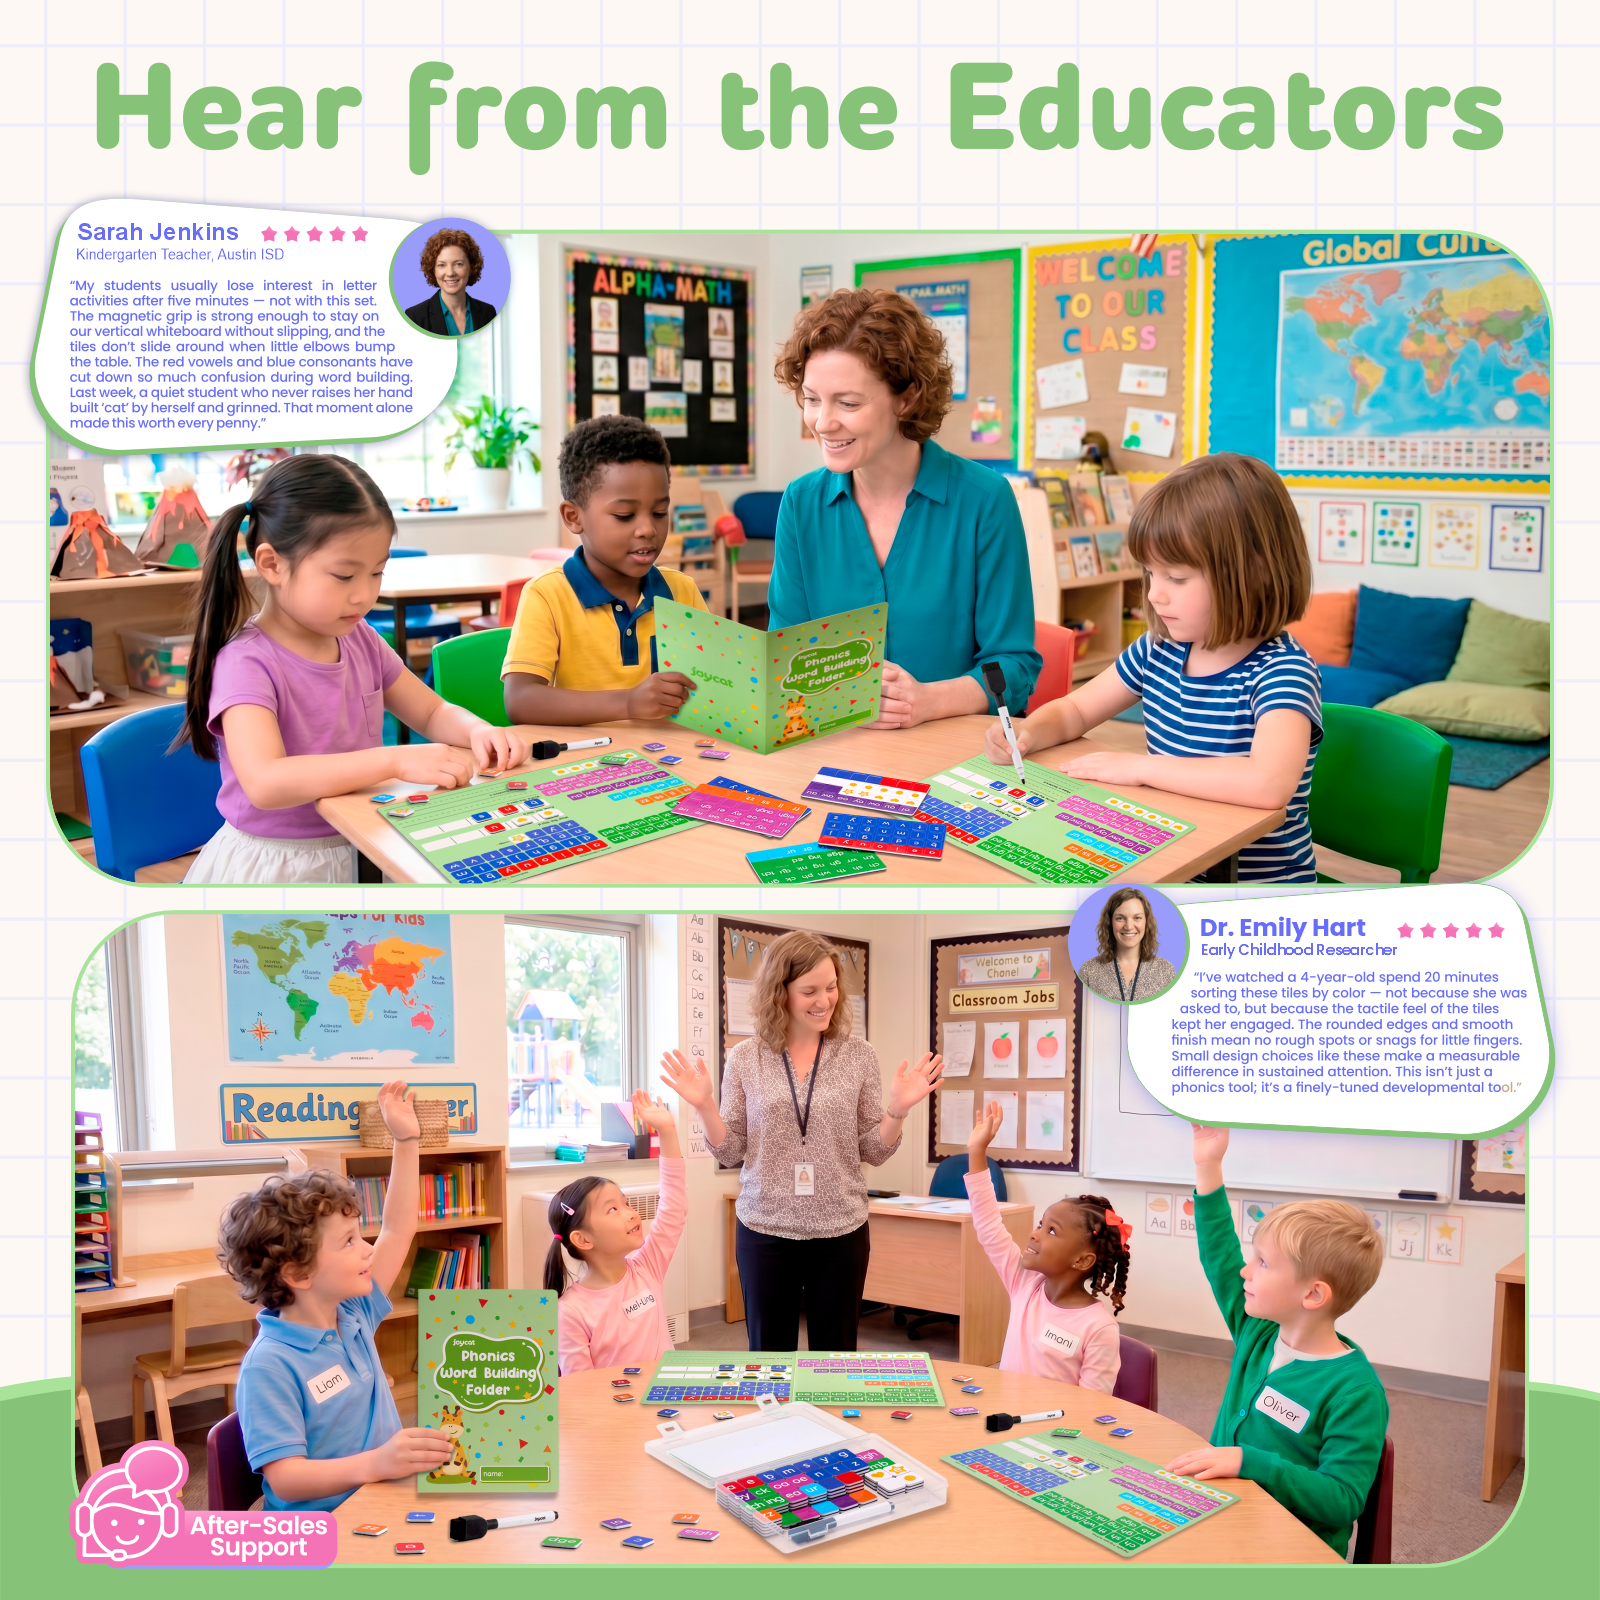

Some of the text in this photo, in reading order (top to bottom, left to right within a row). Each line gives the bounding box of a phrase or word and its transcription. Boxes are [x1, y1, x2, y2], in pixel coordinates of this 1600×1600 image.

[1303, 234, 1400, 266] Global
[1036, 250, 1183, 286] WELCOME
[593, 267, 733, 305] ALPHA-MATH
[1055, 289, 1164, 319] TO OUR
[1063, 326, 1157, 354] CLASS
[805, 650, 851, 668] Phonics
[690, 666, 734, 688] joycat
[785, 655, 868, 684] Word Building
[808, 671, 845, 688] Folder
[975, 954, 1034, 967] Welcome to
[952, 989, 1055, 1007] Classroom Jobs
[232, 1093, 361, 1130] Reading
[1150, 1216, 1167, 1229] Aa
[1180, 1219, 1196, 1231] Bb
[1399, 1239, 1413, 1257] Jj
[1436, 1243, 1452, 1257] Kk
[453, 1339, 475, 1347] joycat
[1044, 1329, 1074, 1349] Imani
[461, 1350, 515, 1362] Phonics
[440, 1366, 537, 1382] Word Building
[315, 1374, 343, 1394] Liam
[466, 1383, 511, 1396] Folder
[1263, 1395, 1300, 1422] Oliver
[483, 1470, 504, 1478] name:
